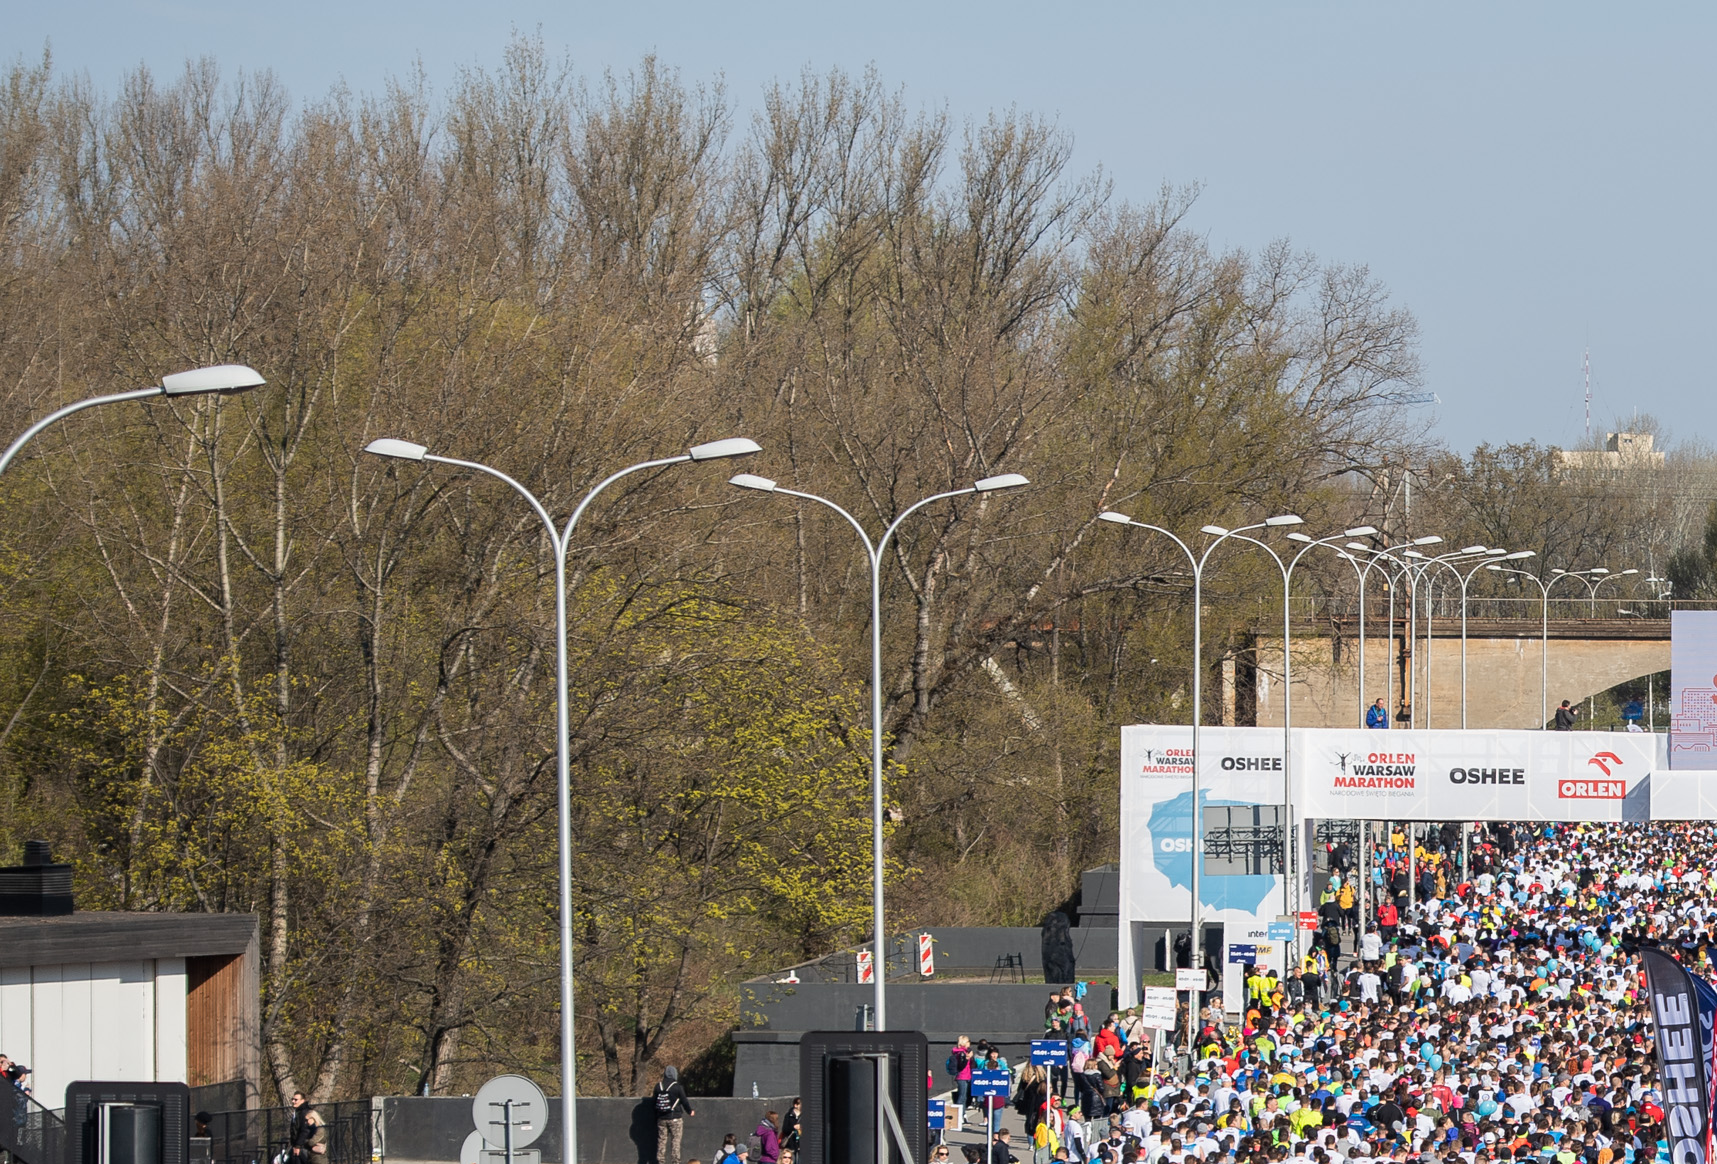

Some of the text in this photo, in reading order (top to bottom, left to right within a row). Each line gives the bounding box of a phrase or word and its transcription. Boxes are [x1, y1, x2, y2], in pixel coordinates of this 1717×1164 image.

[1166, 749, 1194, 757] ORLE
[1368, 753, 1415, 764] ORLEN
[1221, 757, 1282, 771] OSHEE
[1143, 766, 1194, 774] MARATHO
[1353, 765, 1415, 776] WARSAW
[1450, 768, 1525, 785] OSHEE
[1334, 777, 1415, 788] MARATHON
[1561, 782, 1623, 797] ORLEN
